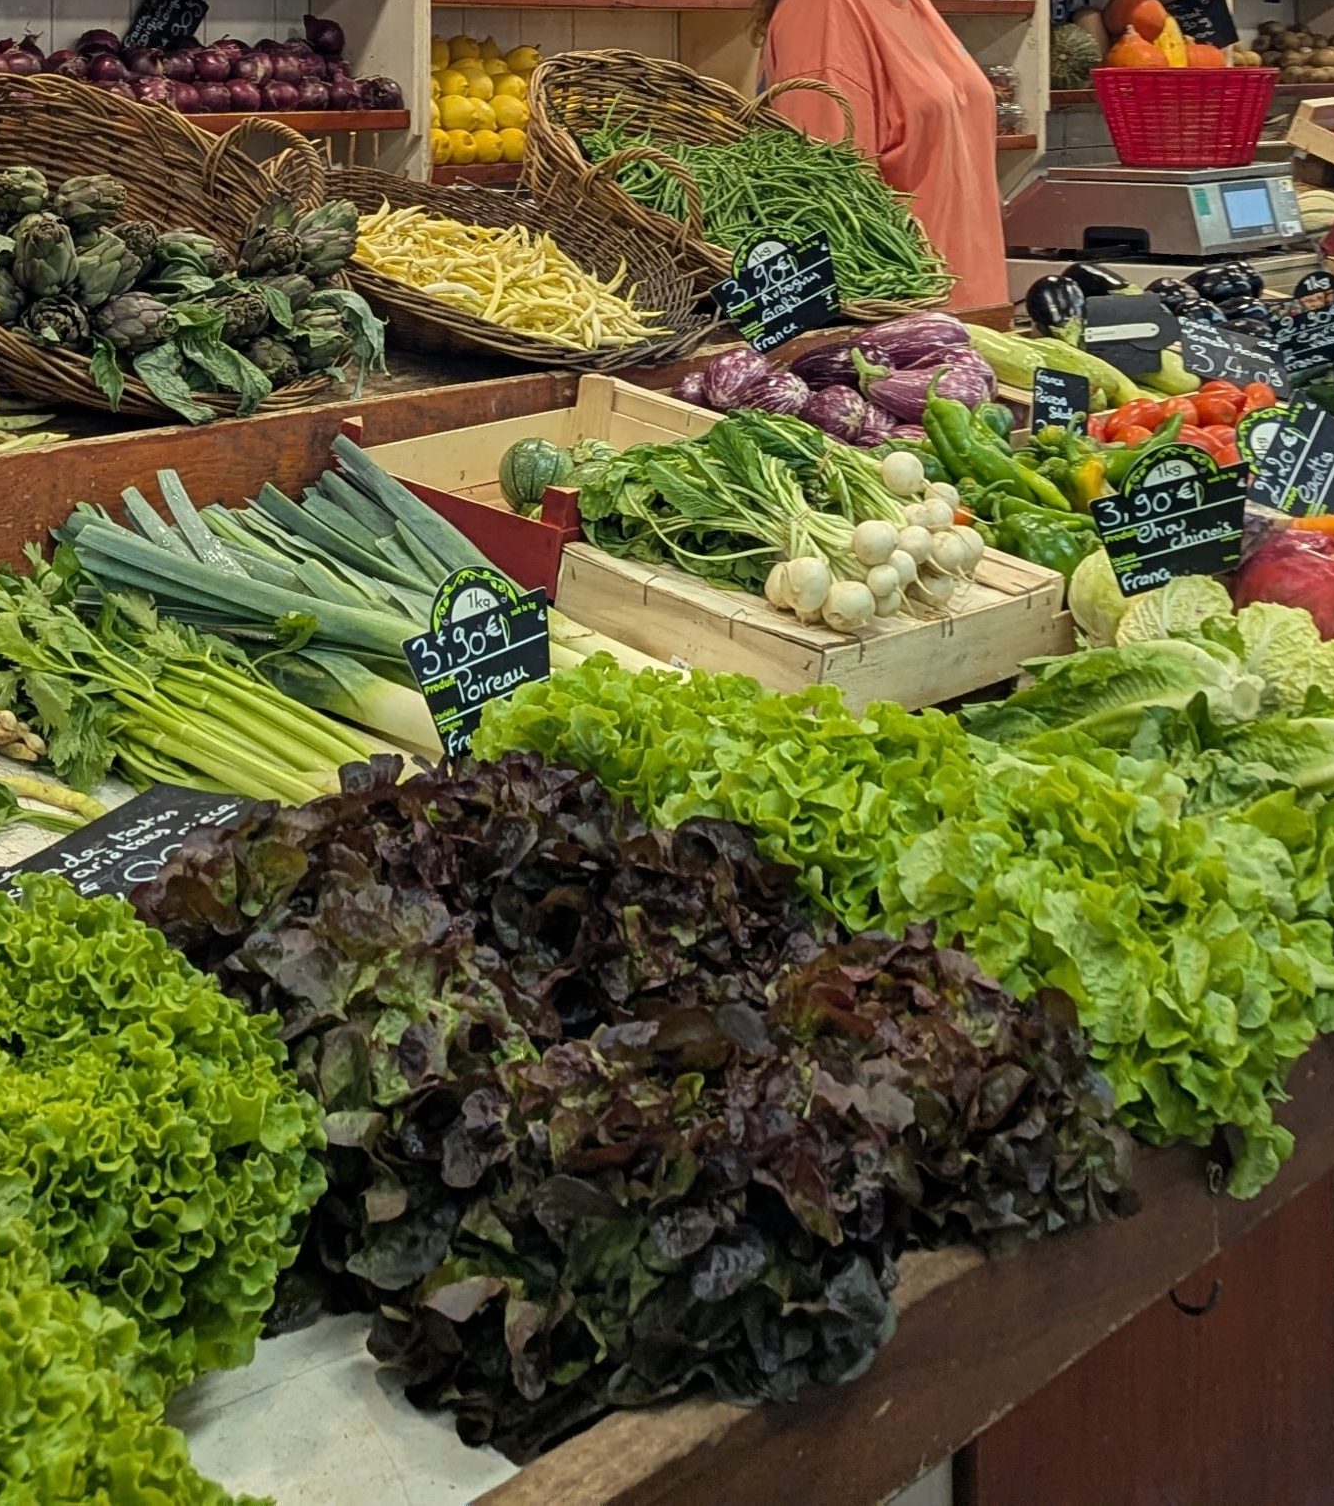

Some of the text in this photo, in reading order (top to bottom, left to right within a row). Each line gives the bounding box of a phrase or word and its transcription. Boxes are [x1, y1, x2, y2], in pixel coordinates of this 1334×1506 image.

[466, 590, 492, 609] 1kg
[424, 674, 456, 696] Produit
[453, 665, 531, 704] Poireau
[447, 729, 470, 757] Fra
